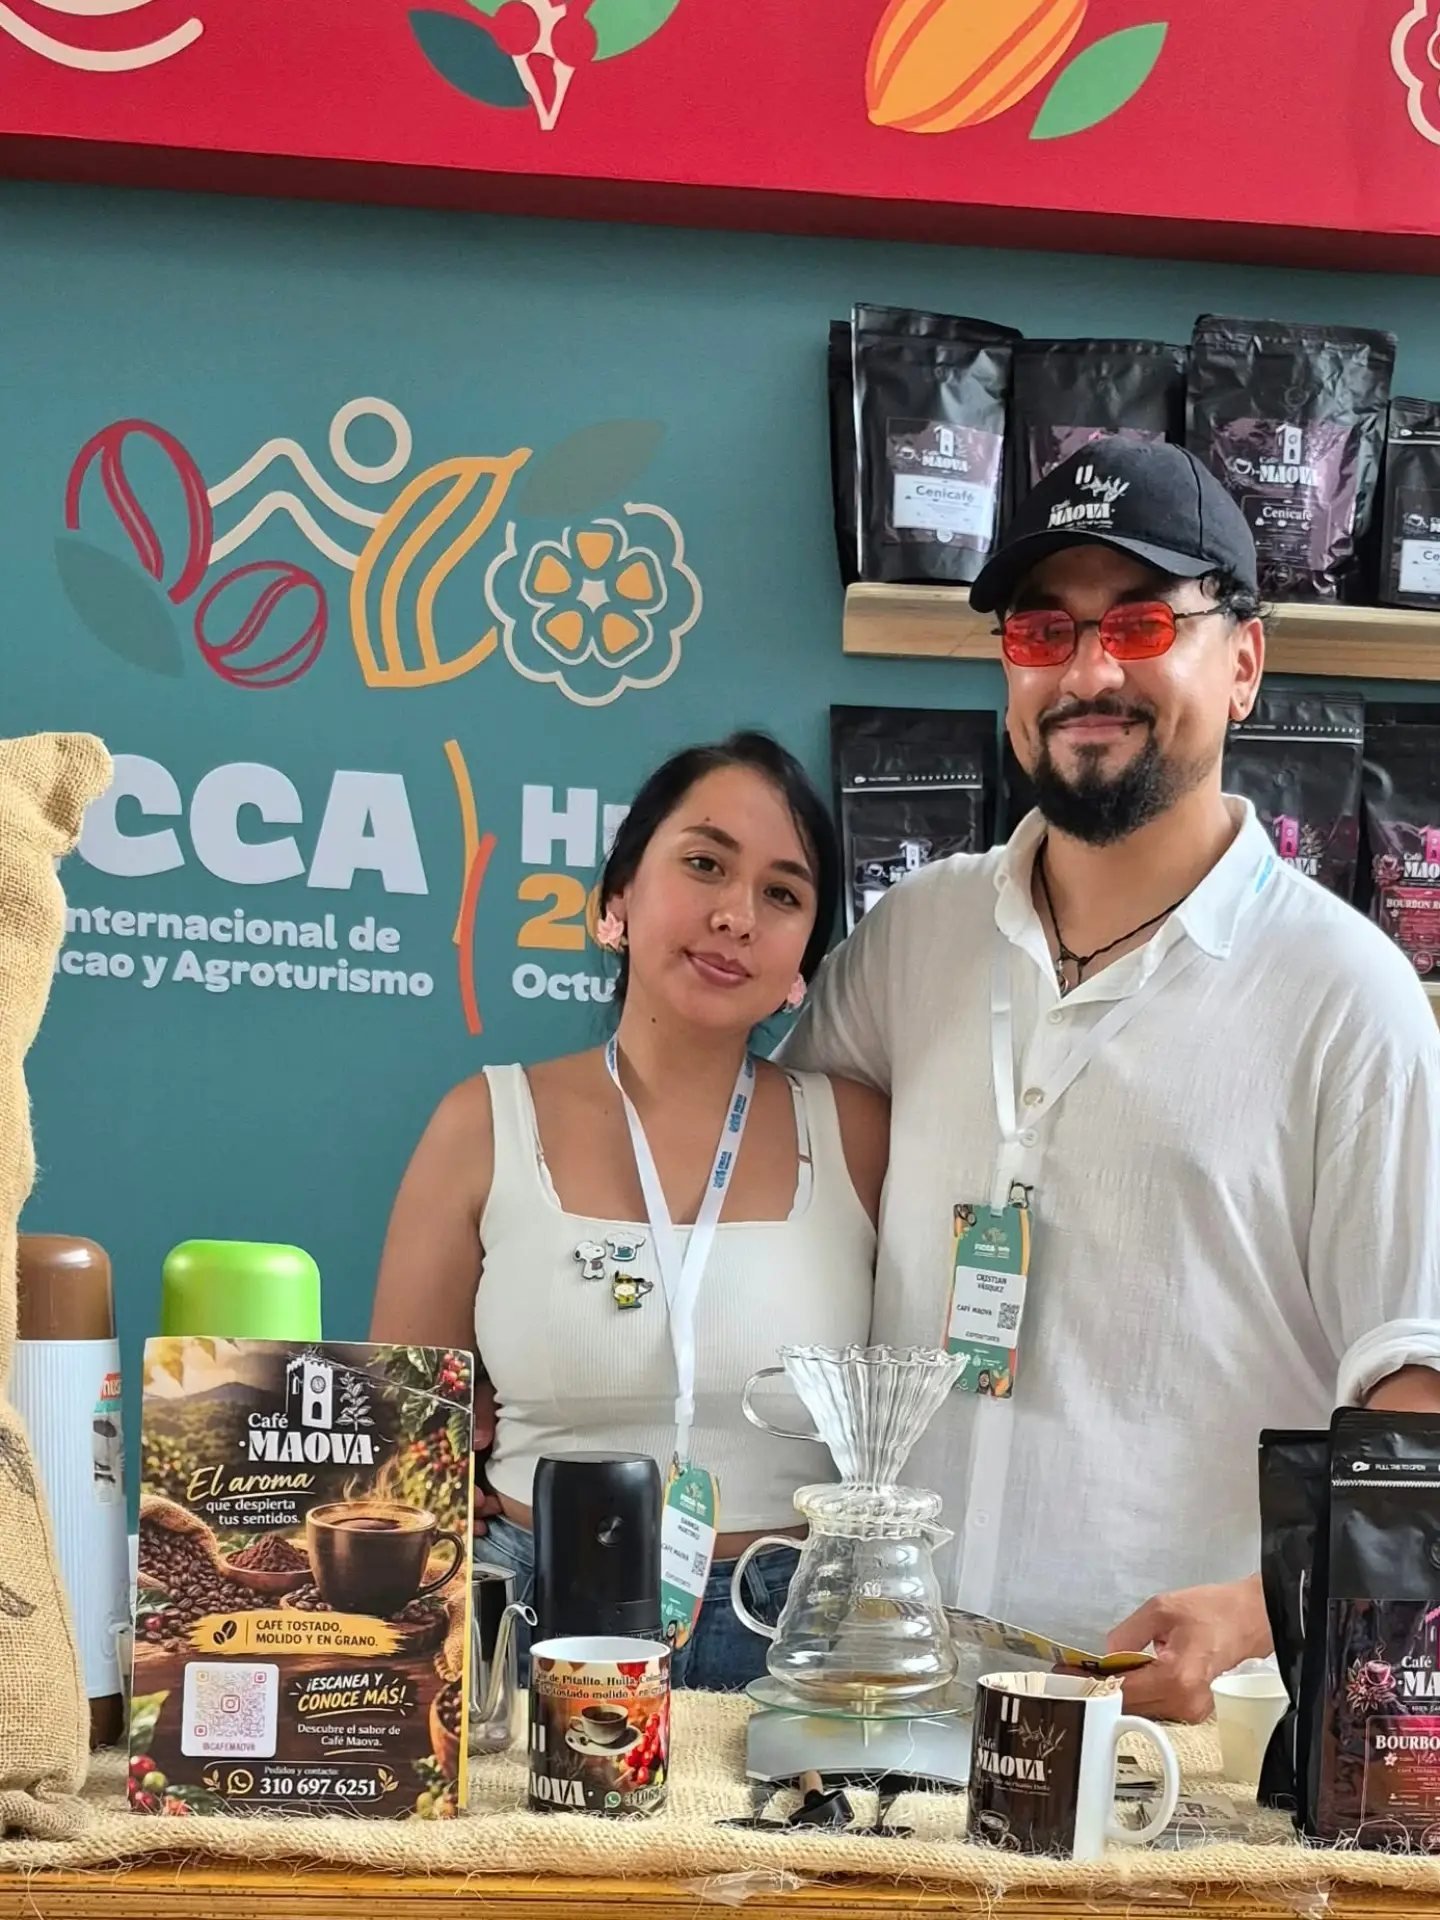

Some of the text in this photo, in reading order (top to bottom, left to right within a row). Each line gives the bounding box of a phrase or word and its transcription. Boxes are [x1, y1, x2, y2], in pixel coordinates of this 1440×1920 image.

[916, 485, 975, 502] Cenicafé
[72, 754, 429, 895] CCA
[1386, 898, 1429, 909] BOURBON
[65, 905, 401, 953] nternacional de
[54, 949, 434, 998] cao y Agroturismo
[248, 1412, 288, 1429] Café
[248, 1430, 374, 1465] MAOVA
[186, 1464, 316, 1501] El aroma
[206, 1499, 296, 1515] que despierta
[219, 1512, 301, 1525] tus sentidos.
[287, 1620, 342, 1633] TOSTADO,
[256, 1633, 378, 1647] MOLIDO Y EN GRANO.
[1400, 1655, 1432, 1669] Café
[306, 1673, 384, 1693] ¡ESCANEA Y
[297, 1684, 407, 1712] CONOCE MÁS!
[297, 1723, 401, 1735] Descubre el sabor de
[320, 1735, 383, 1747] Café Maova.
[264, 1766, 295, 1774] Pedidos
[259, 1777, 377, 1796] 310 697 6251
